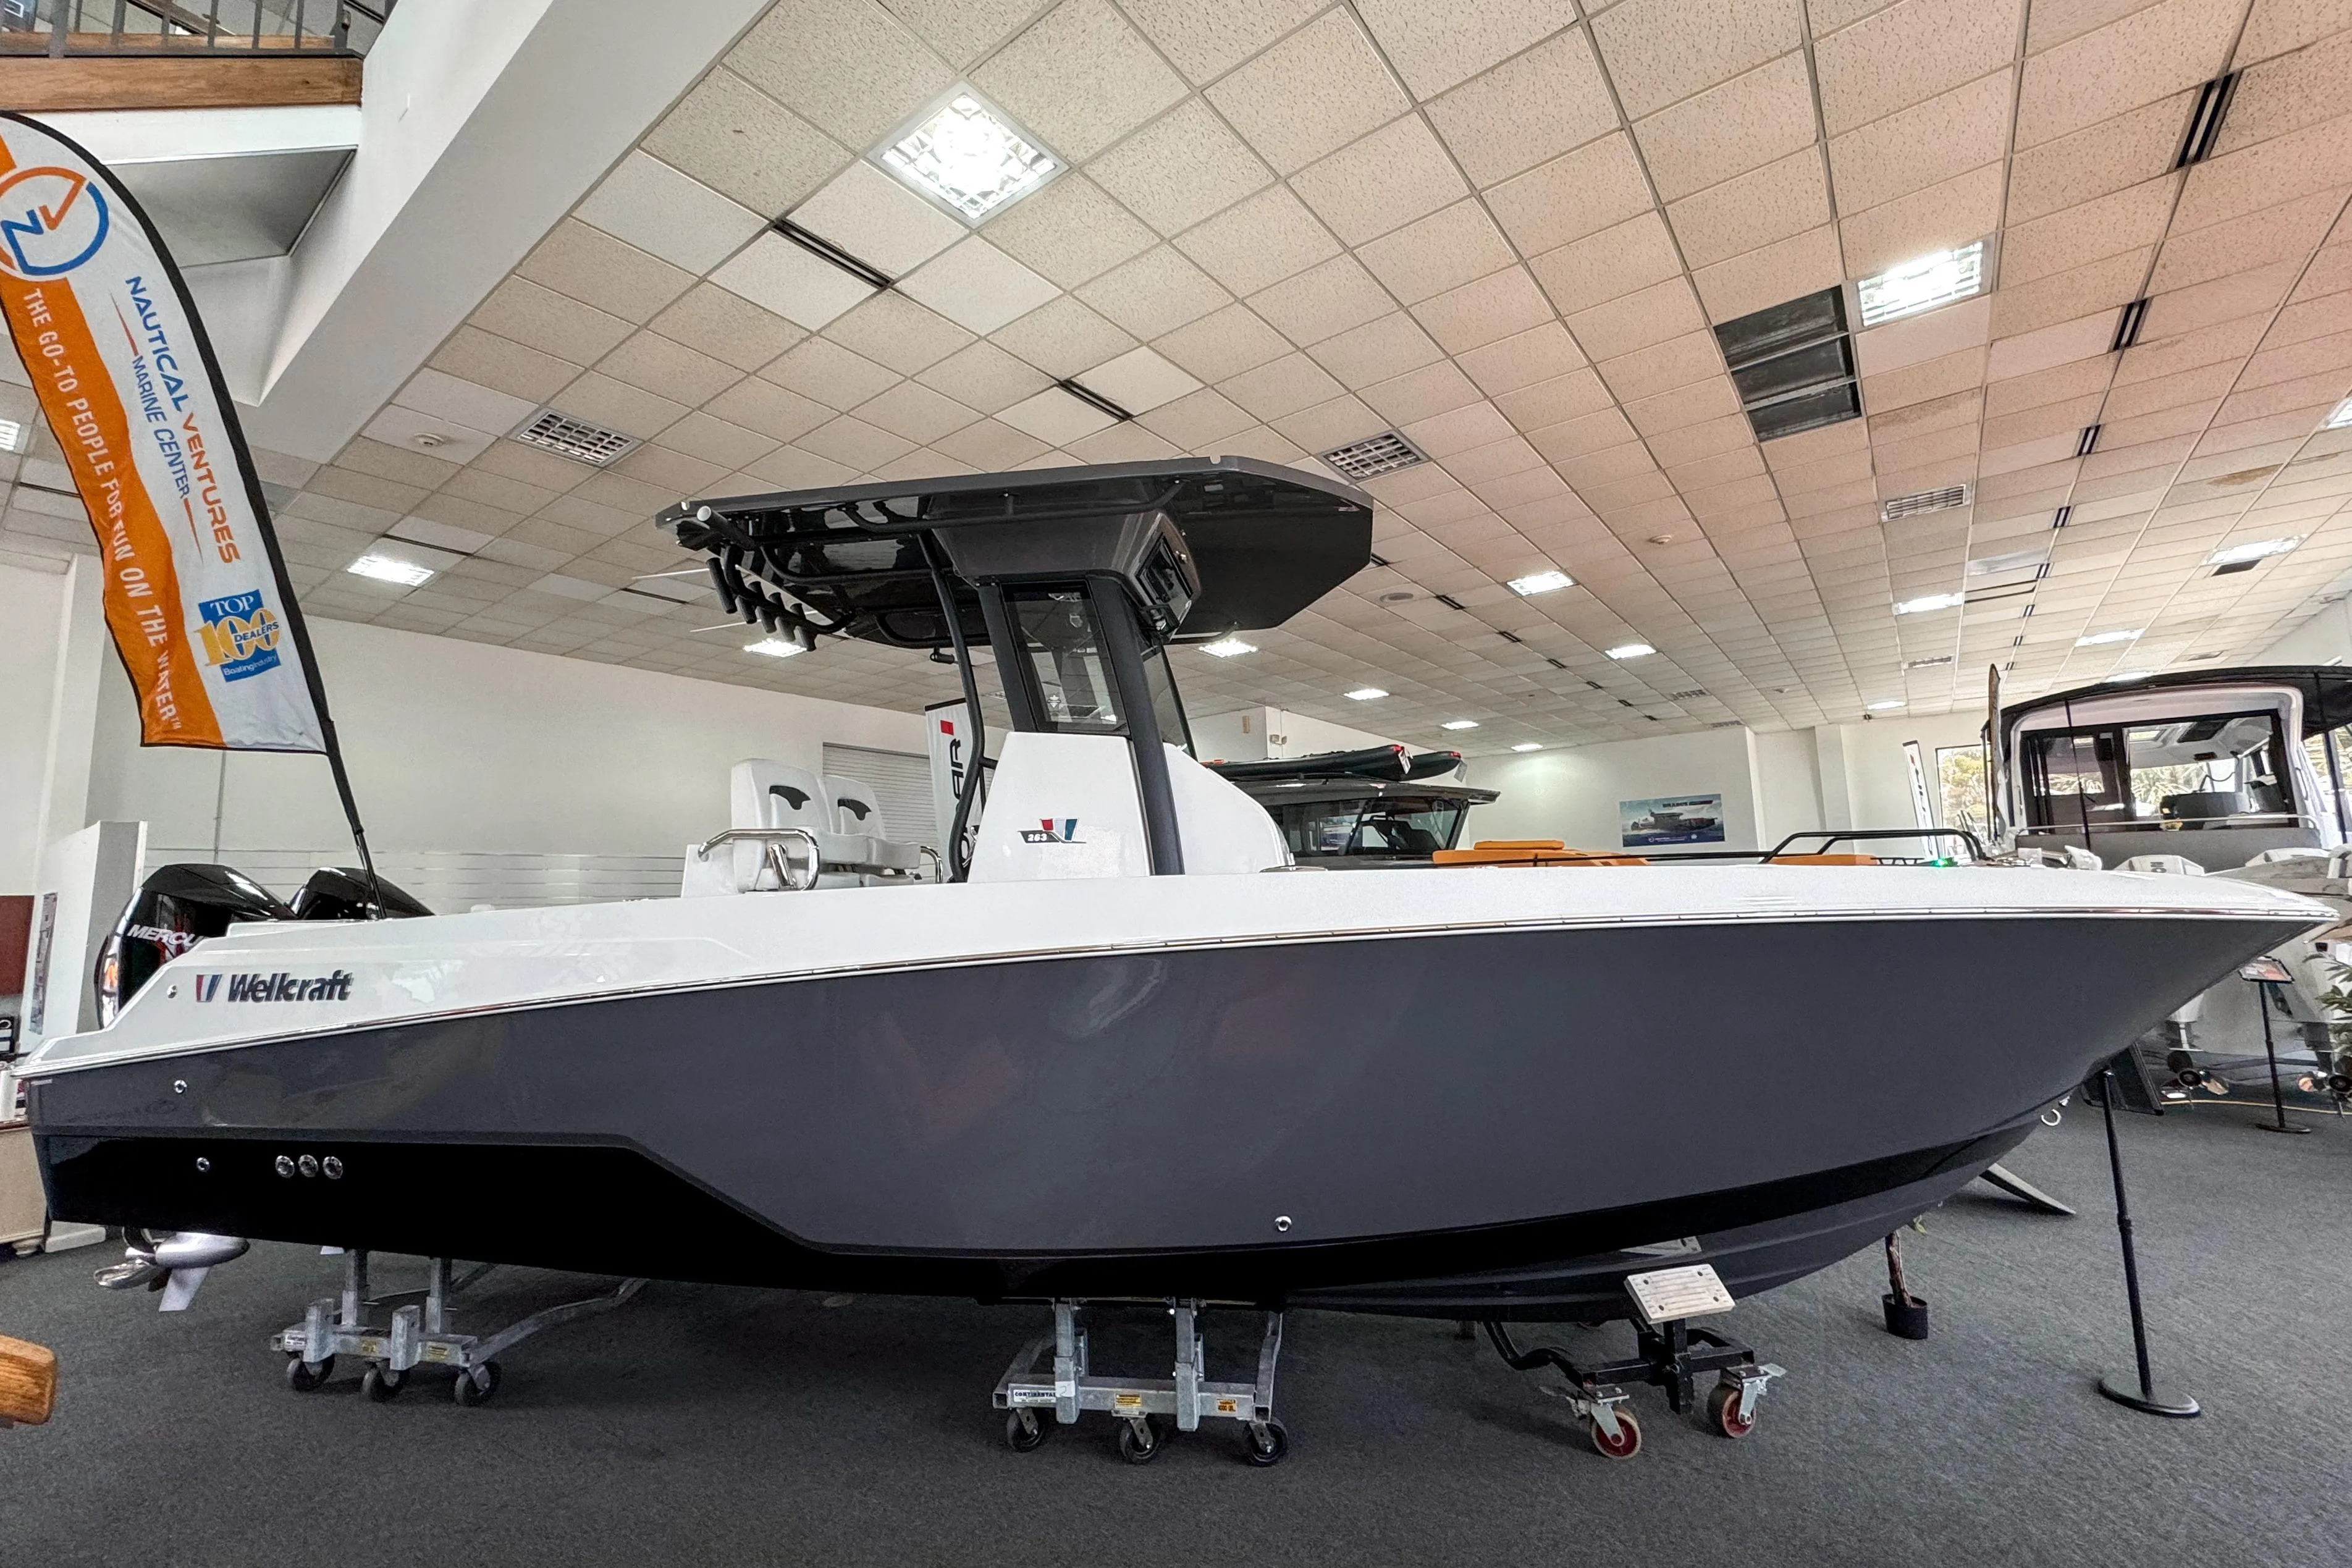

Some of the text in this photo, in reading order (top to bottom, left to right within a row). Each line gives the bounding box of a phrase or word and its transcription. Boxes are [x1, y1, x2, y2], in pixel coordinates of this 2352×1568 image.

[23, 288, 51, 327] THE
[38, 332, 78, 393] GO-TO
[66, 397, 114, 477] PEOPLE
[125, 275, 242, 565] NAUTICAL VENTURES
[132, 354, 191, 500] MARINE CENTER
[99, 481, 123, 516] FOR
[111, 520, 136, 562] FUN
[119, 567, 153, 599] ON
[137, 604, 168, 647] THE
[209, 595, 255, 617] TOP
[193, 607, 280, 667] 100
[234, 621, 280, 643] DEALERS
[1027, 833, 1048, 842] 263
[127, 924, 211, 948] MERCU
[227, 969, 354, 1003] Wellcraft
